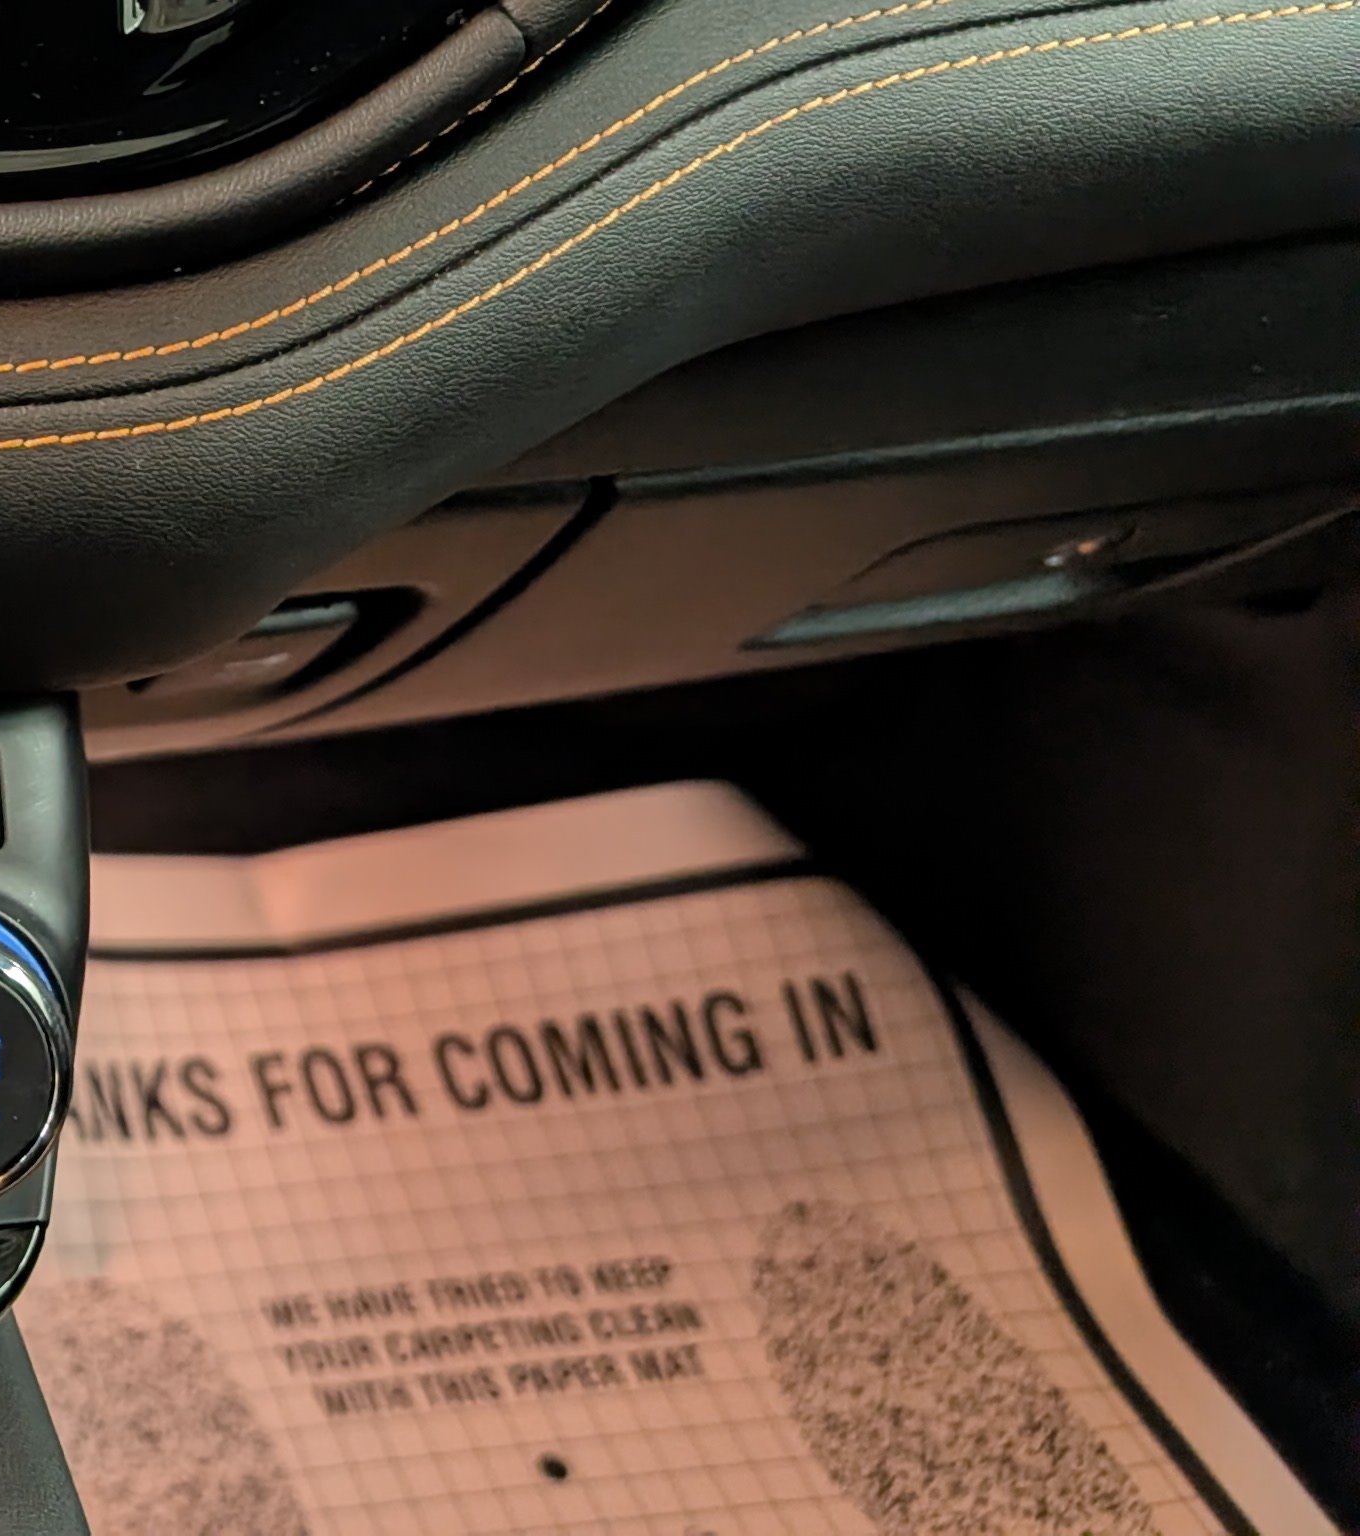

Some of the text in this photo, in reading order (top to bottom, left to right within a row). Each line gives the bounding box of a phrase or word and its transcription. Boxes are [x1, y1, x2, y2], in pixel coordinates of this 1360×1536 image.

[250, 1040, 420, 1130] FOR
[431, 987, 764, 1114] COMING
[780, 970, 878, 1064] IN
[534, 1264, 583, 1298] TO
[278, 1335, 377, 1375] YOUR
[587, 1300, 705, 1341] CLEAN
[312, 1343, 707, 1417] WITH THIS PAPER MAT
